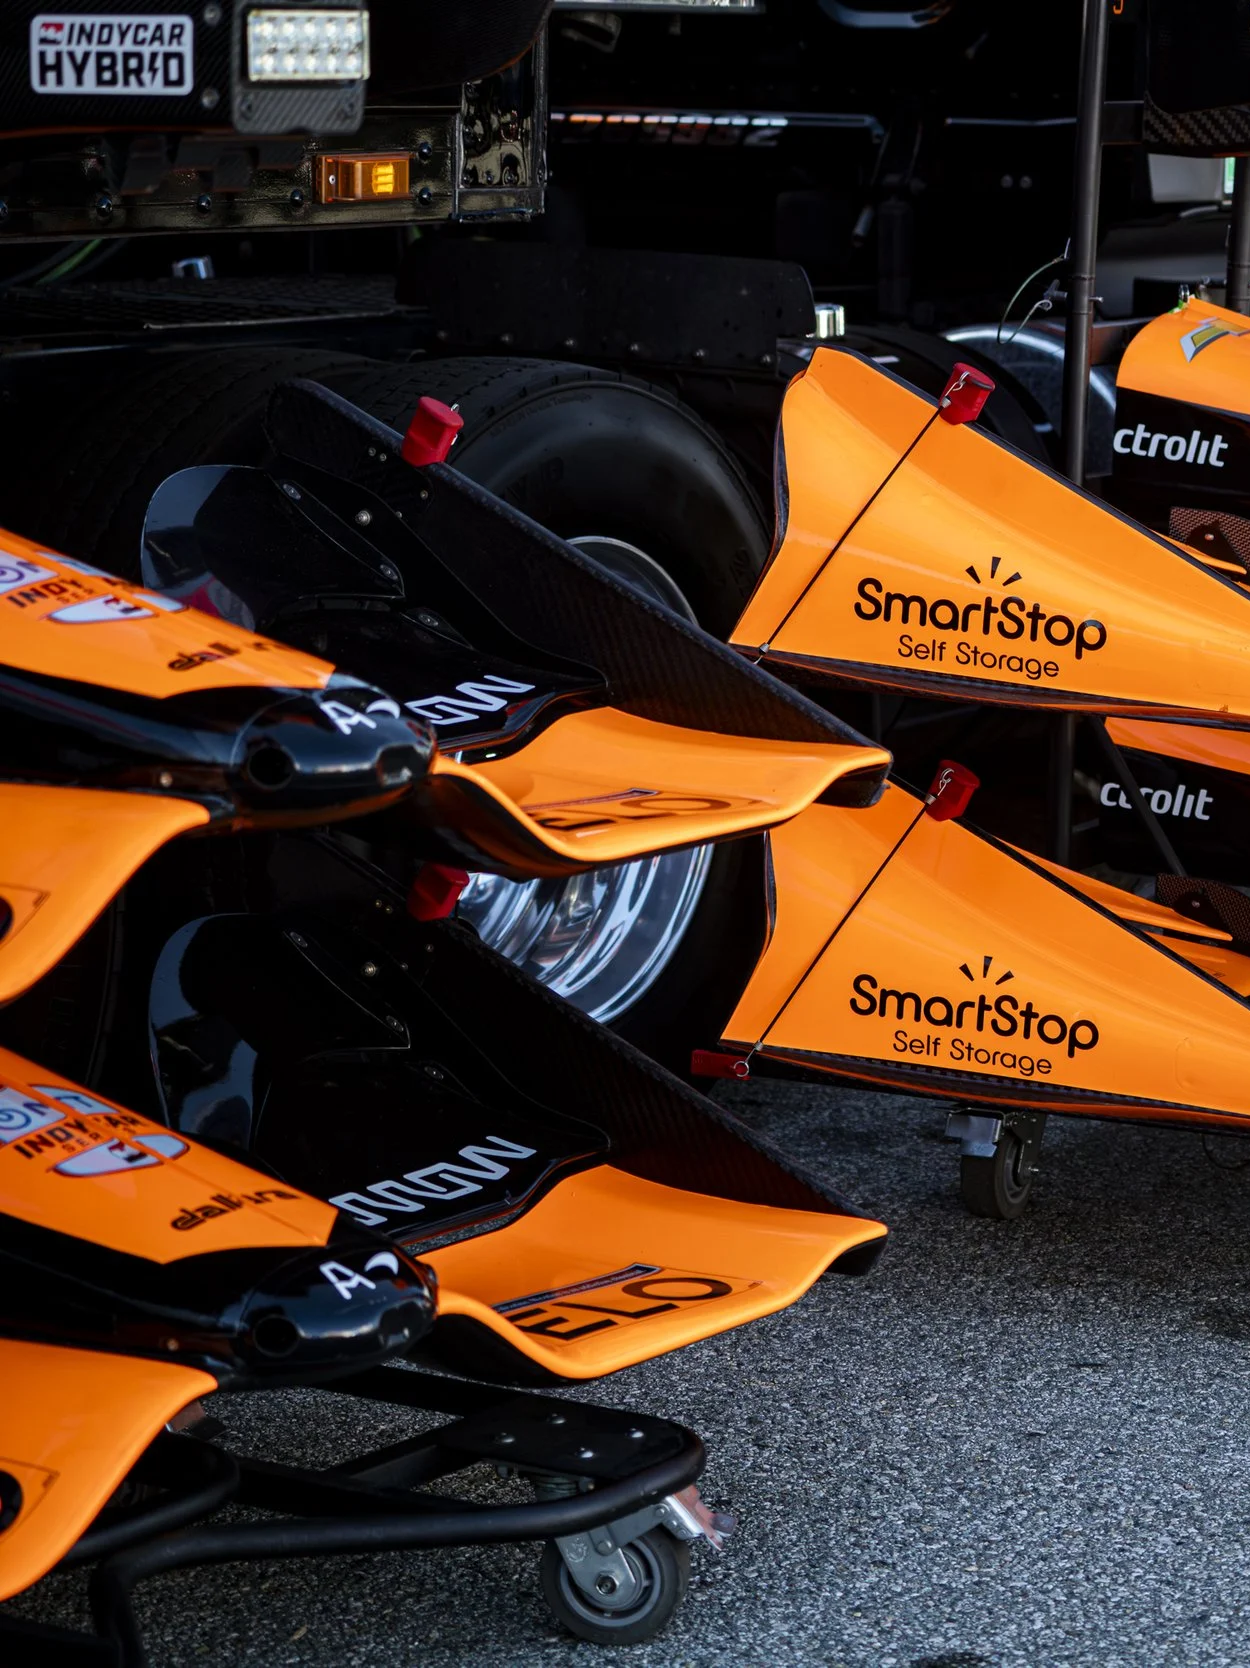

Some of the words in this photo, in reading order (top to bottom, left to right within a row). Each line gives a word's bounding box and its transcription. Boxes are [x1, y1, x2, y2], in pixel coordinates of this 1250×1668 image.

[67, 22, 185, 46] INDYCAR
[854, 577, 1107, 660] SmartStop
[898, 635, 946, 661] Self
[956, 642, 1059, 680] Storage
[850, 974, 1099, 1058] SmartStop
[893, 1030, 941, 1057] Self
[949, 1038, 1052, 1077] Storage
